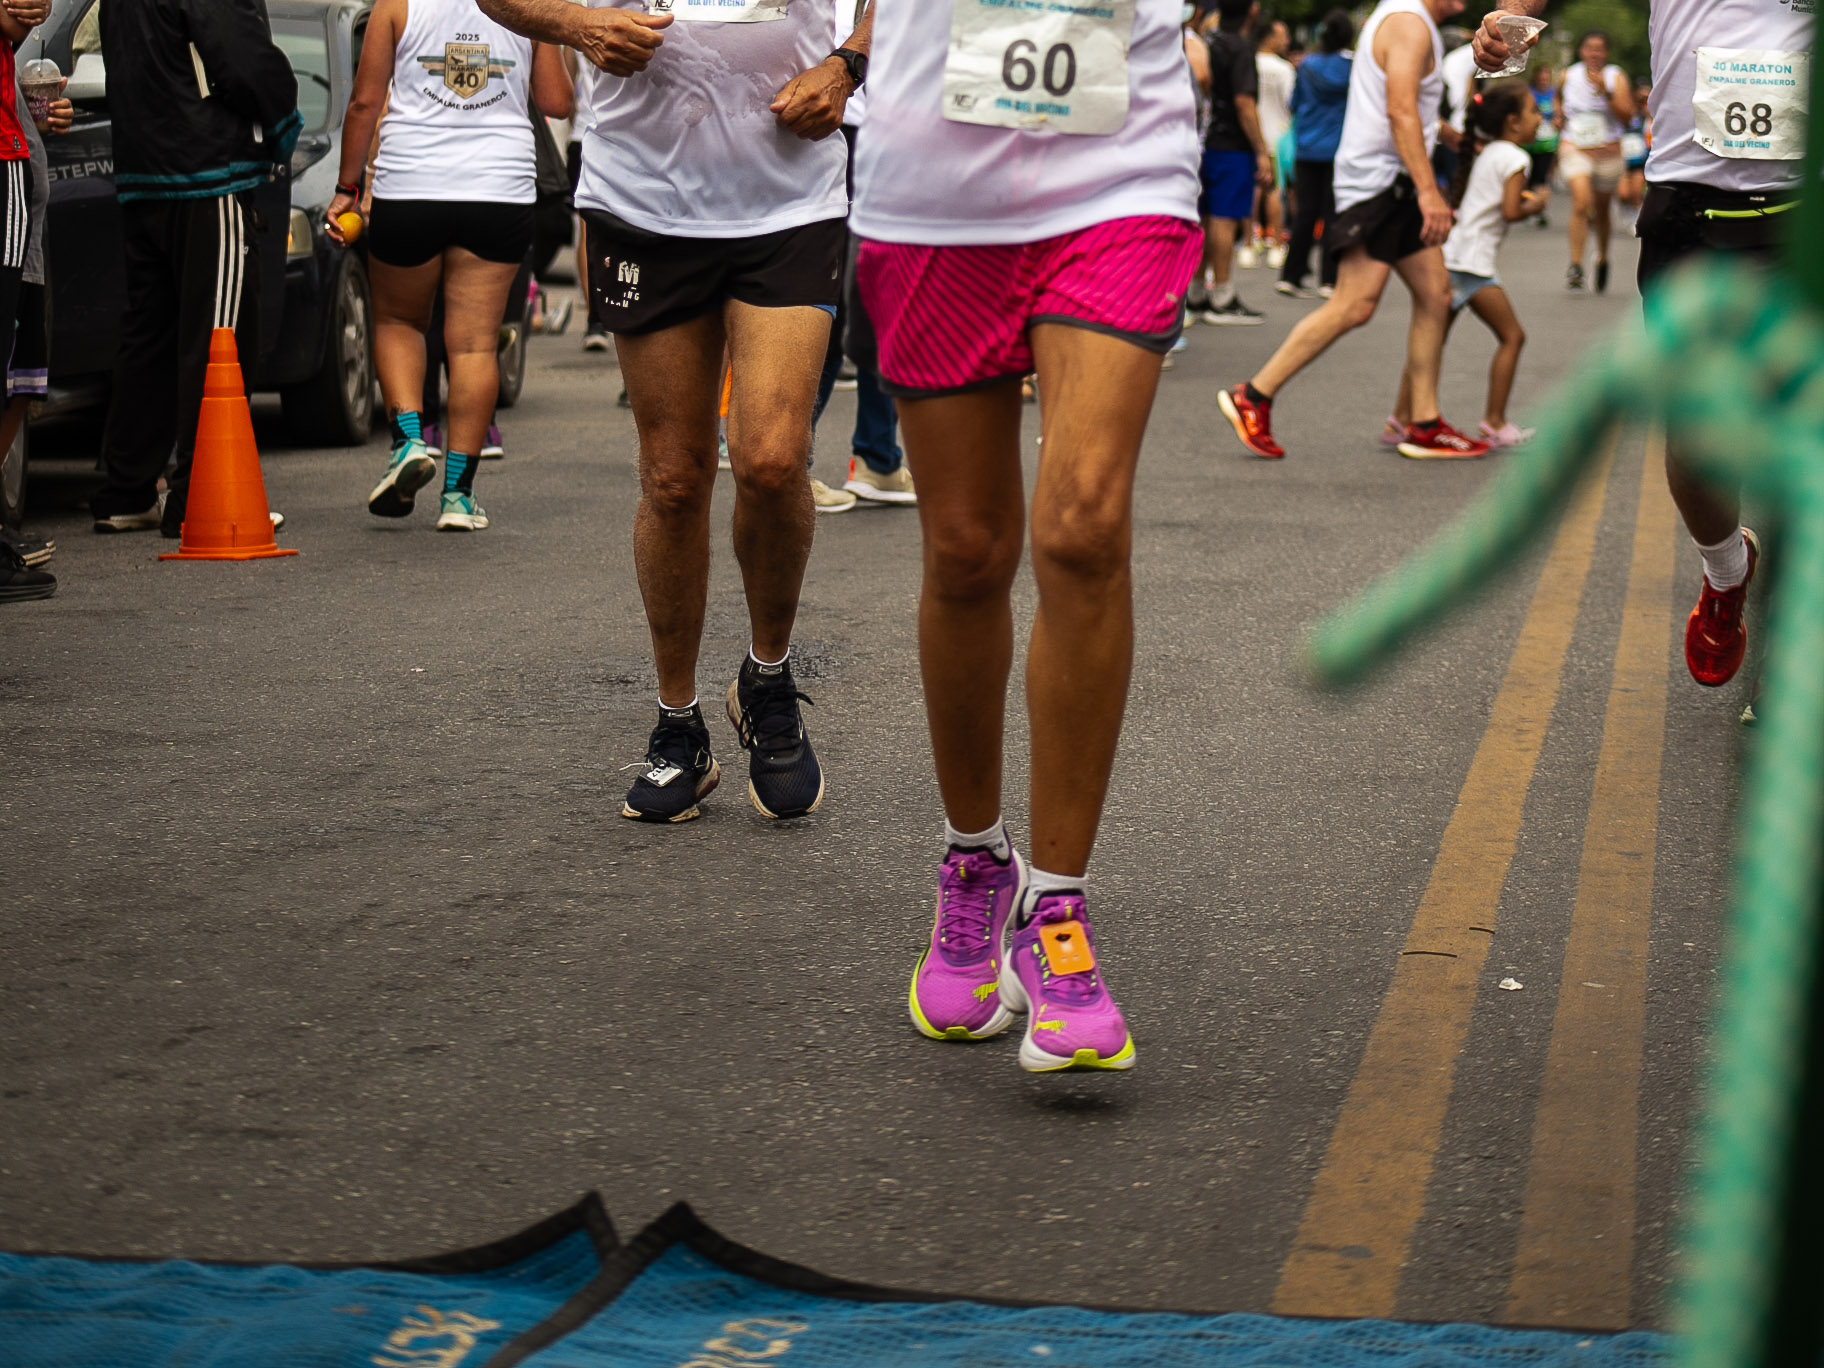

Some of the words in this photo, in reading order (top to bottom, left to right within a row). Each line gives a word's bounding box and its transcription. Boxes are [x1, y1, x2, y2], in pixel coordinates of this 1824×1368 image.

[455, 33, 480, 42] 2025
[1002, 38, 1077, 97] 60
[1713, 62, 1727, 71] 40
[1730, 63, 1792, 74] MARATON
[453, 72, 479, 88] 40
[1750, 78, 1796, 86] GRANEROS
[423, 87, 461, 110] EMPALME
[462, 90, 508, 110] GRANEROS
[1724, 101, 1772, 137] 68
